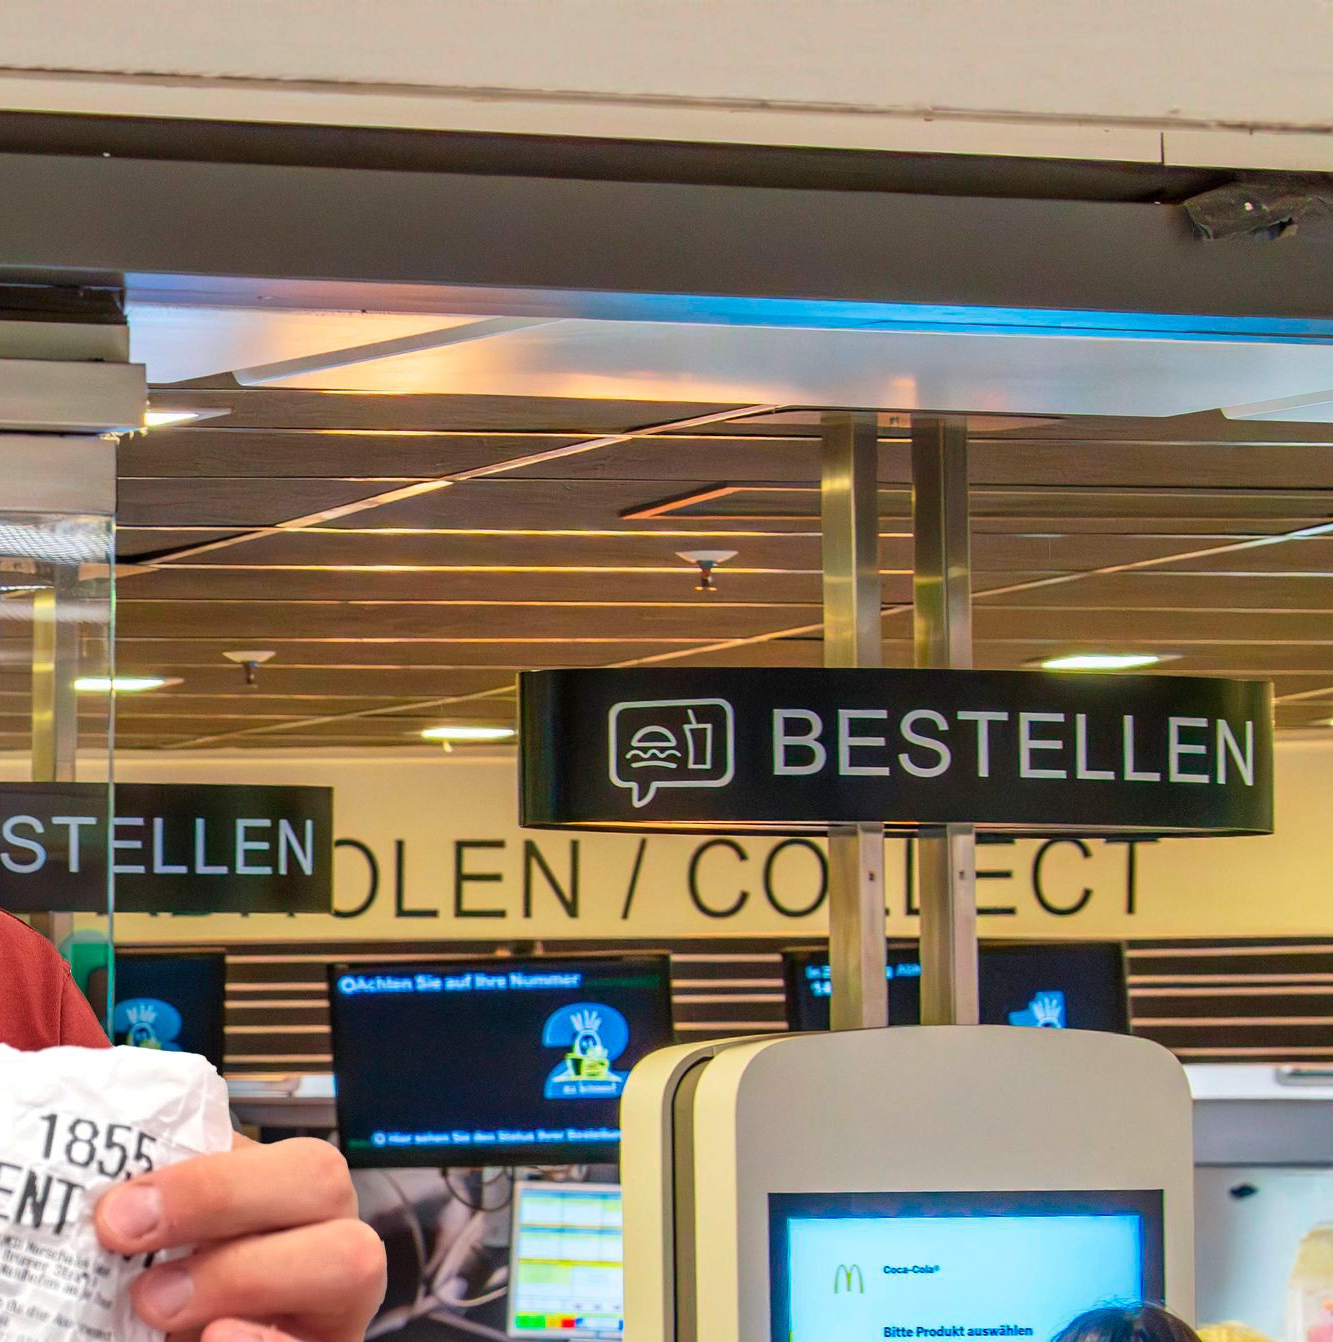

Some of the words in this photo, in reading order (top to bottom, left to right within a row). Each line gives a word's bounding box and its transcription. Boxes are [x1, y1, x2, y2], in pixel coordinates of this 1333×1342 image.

[772, 707, 1255, 787] BESTELLEN
[332, 838, 581, 919] OLEN
[355, 976, 413, 992] Achten
[415, 975, 442, 992] Sie
[445, 974, 472, 991] auf
[510, 972, 581, 989] Nummer
[40, 1113, 157, 1181] 1855
[884, 1327, 913, 1338] Bitte
[916, 1326, 965, 1338] Produkt
[967, 1325, 1033, 1337] auswählen
